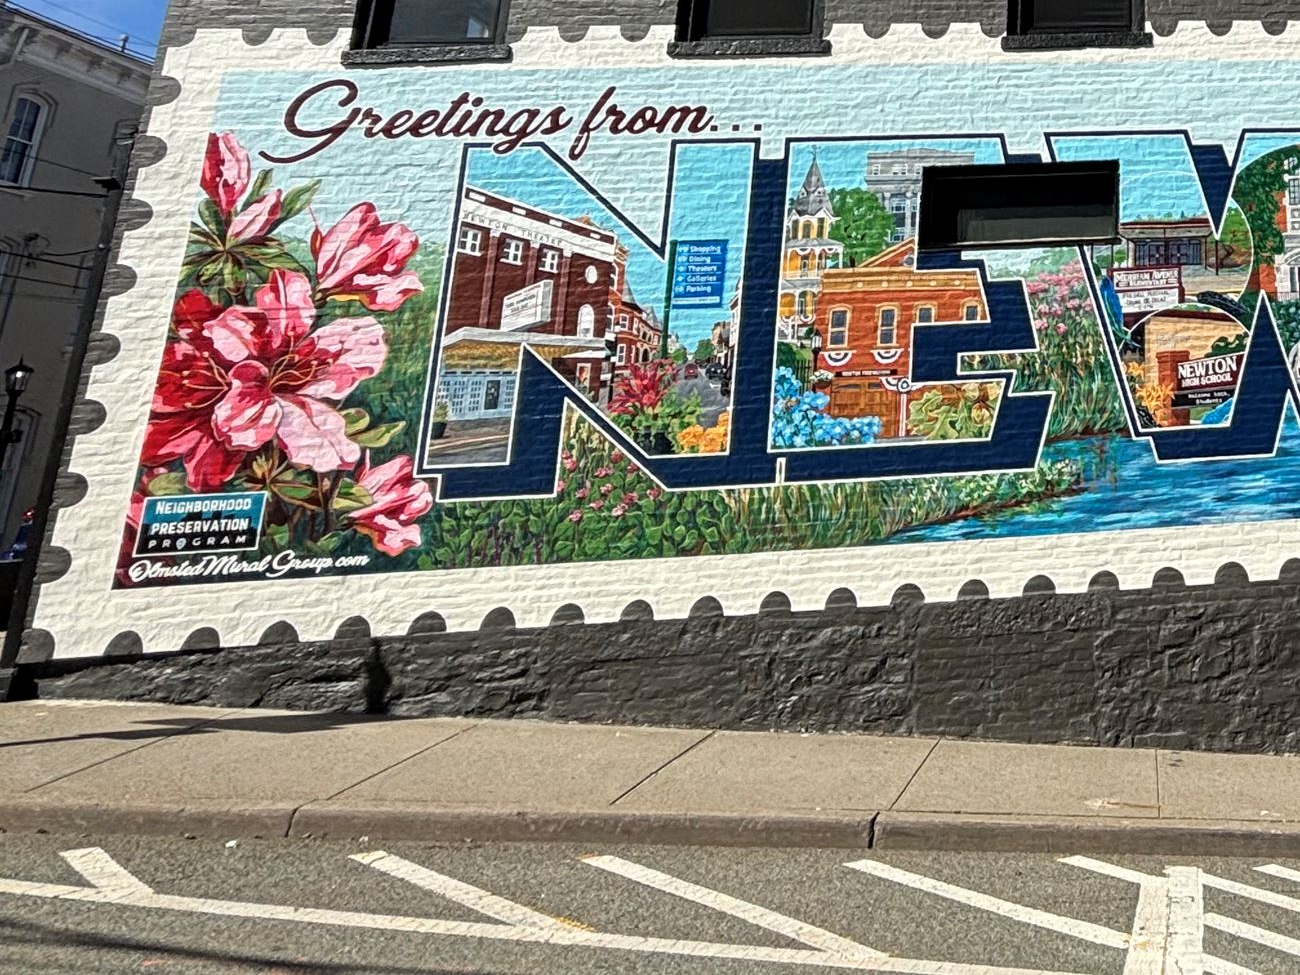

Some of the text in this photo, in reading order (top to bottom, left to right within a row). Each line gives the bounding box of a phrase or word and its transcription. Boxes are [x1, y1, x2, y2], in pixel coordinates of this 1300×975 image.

[258, 78, 763, 164] Greetings from...
[689, 245, 721, 254] Shopping
[688, 256, 711, 264] Dining
[1116, 271, 1151, 283] MERRIAM
[686, 285, 712, 293] Parking
[1177, 356, 1237, 379] NEWTON
[1181, 372, 1233, 387] HIGH SCHOOL
[155, 497, 252, 515] NEIGHBORHOOD
[150, 517, 250, 536] PRESERVATION
